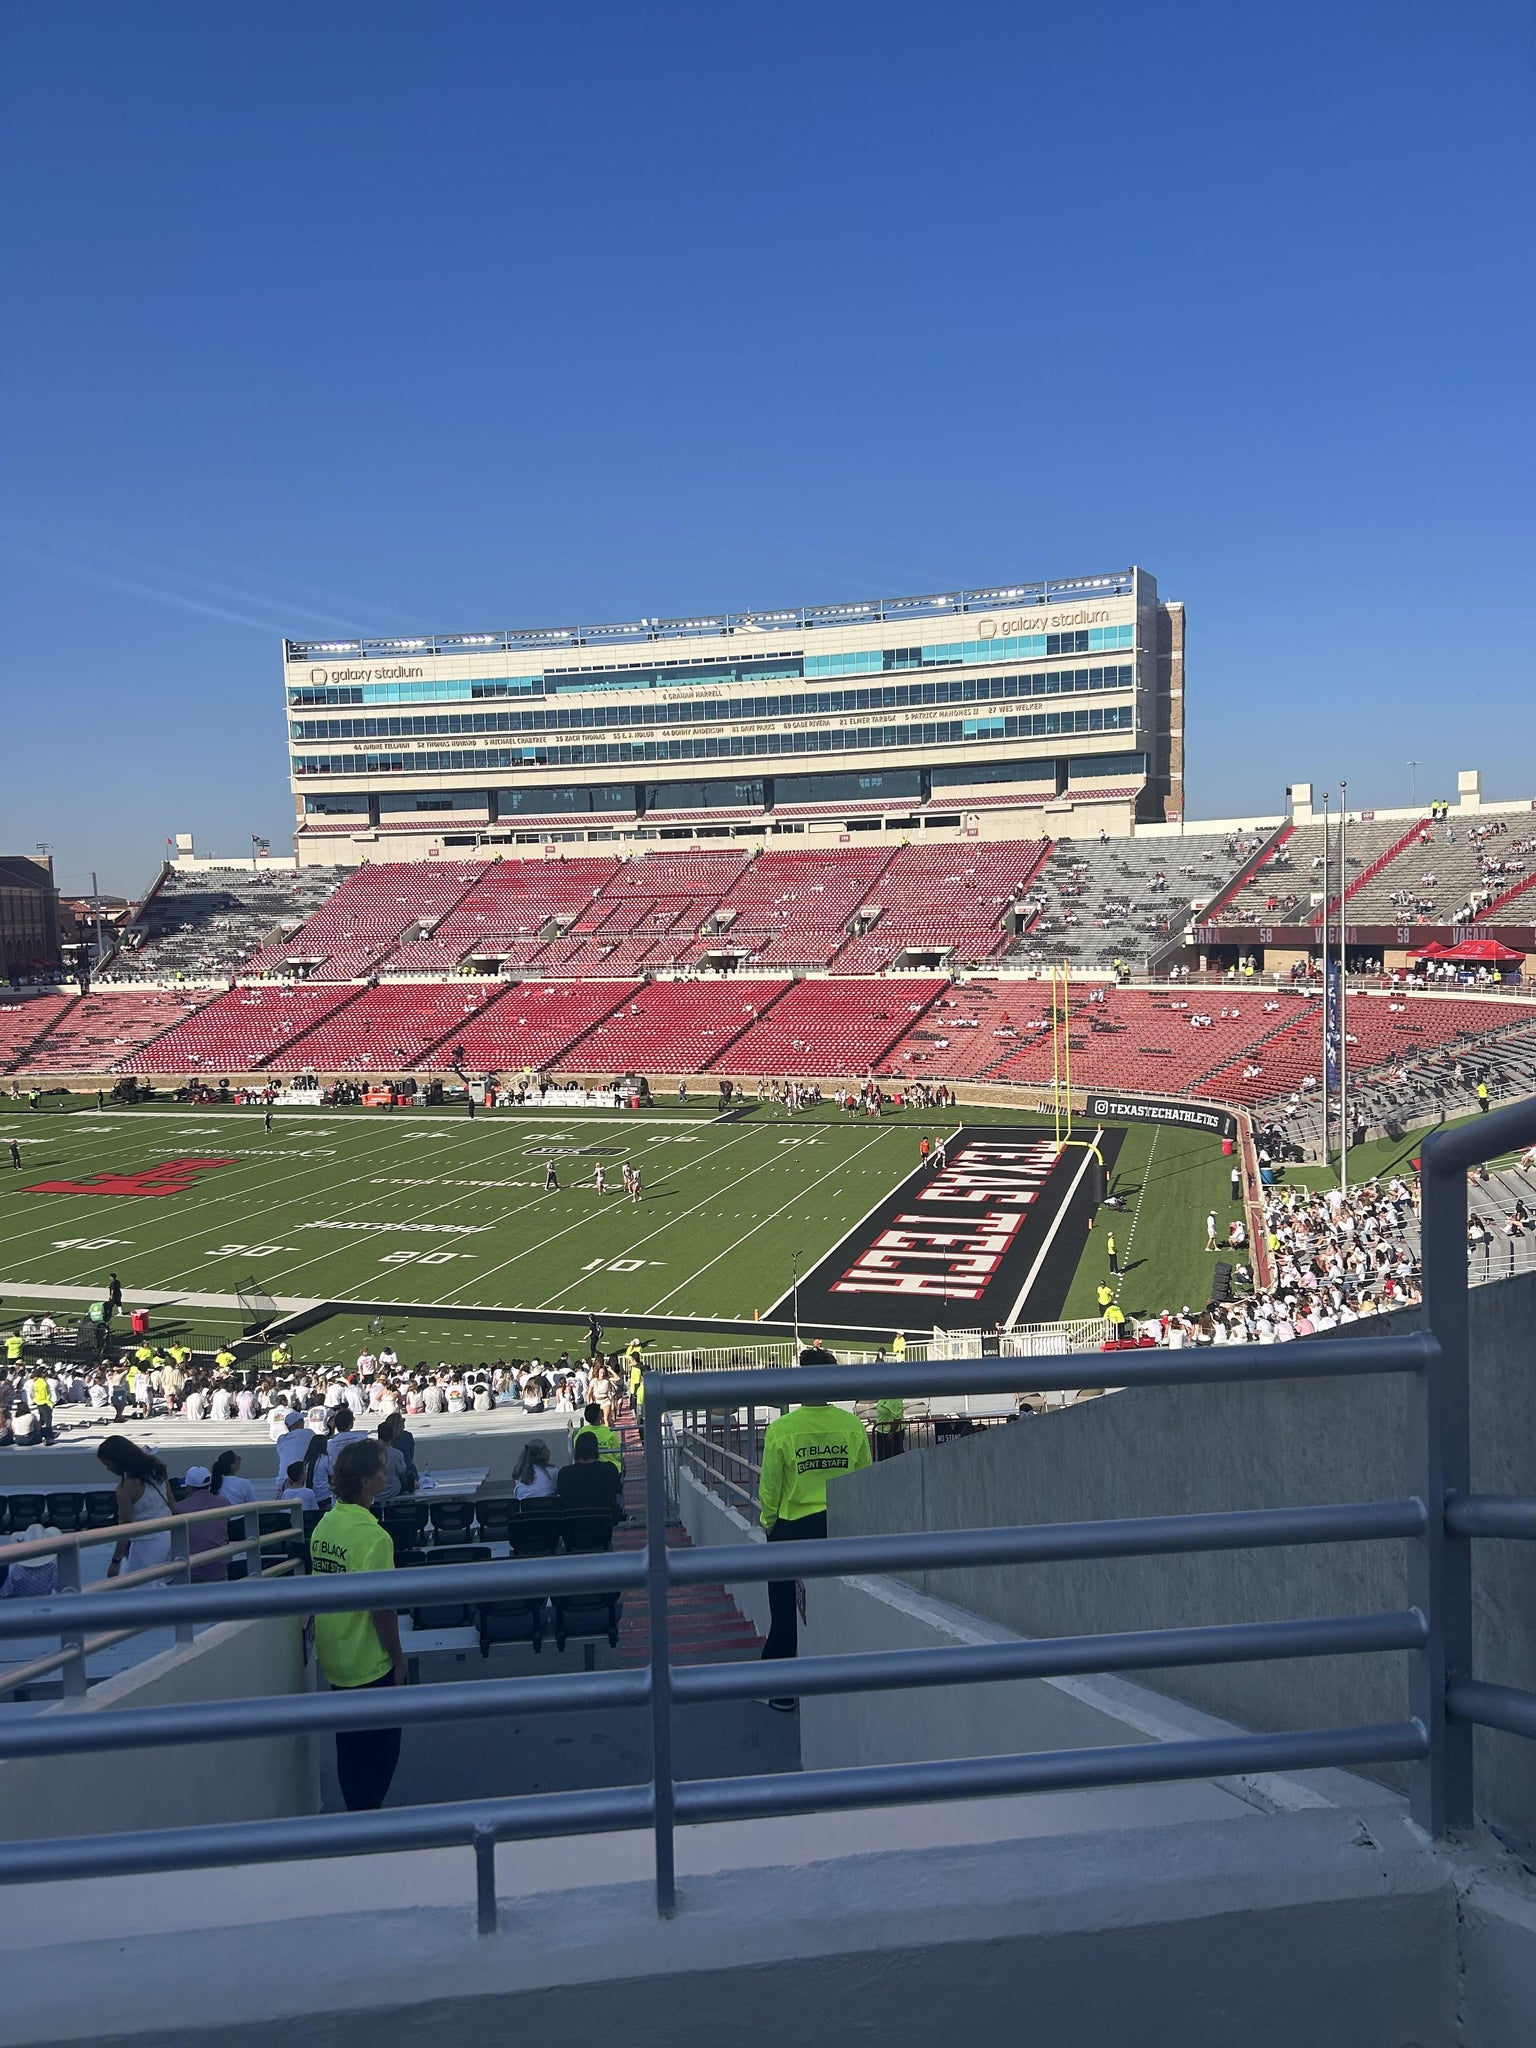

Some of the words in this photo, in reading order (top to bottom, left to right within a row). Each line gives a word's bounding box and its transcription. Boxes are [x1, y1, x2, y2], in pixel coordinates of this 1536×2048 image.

[1002, 617, 1048, 635] galaxy
[1052, 610, 1109, 627] stadium
[331, 668, 371, 683] galaxy
[374, 666, 423, 679] stadium
[668, 691, 694, 700] GRAHAM
[696, 690, 723, 698] HARRELL
[1015, 703, 1043, 711] WELKER
[911, 712, 938, 720] PATRICK
[939, 709, 972, 718] MAHOMES
[1260, 928, 1272, 943] 58
[1397, 927, 1410, 943] 58
[1110, 1103, 1219, 1127] TEXASTECHATHLETICS
[916, 1139, 1067, 1204] TEXAS
[51, 1238, 120, 1249] 40
[204, 1244, 284, 1256] 30
[377, 1251, 459, 1264] 20
[828, 1212, 1027, 1300] TECH
[581, 1258, 646, 1271] 10
[795, 1448, 807, 1458] KT
[810, 1445, 848, 1455] BLACK
[822, 1460, 848, 1468] STAFF
[321, 1542, 348, 1560] BLACK
